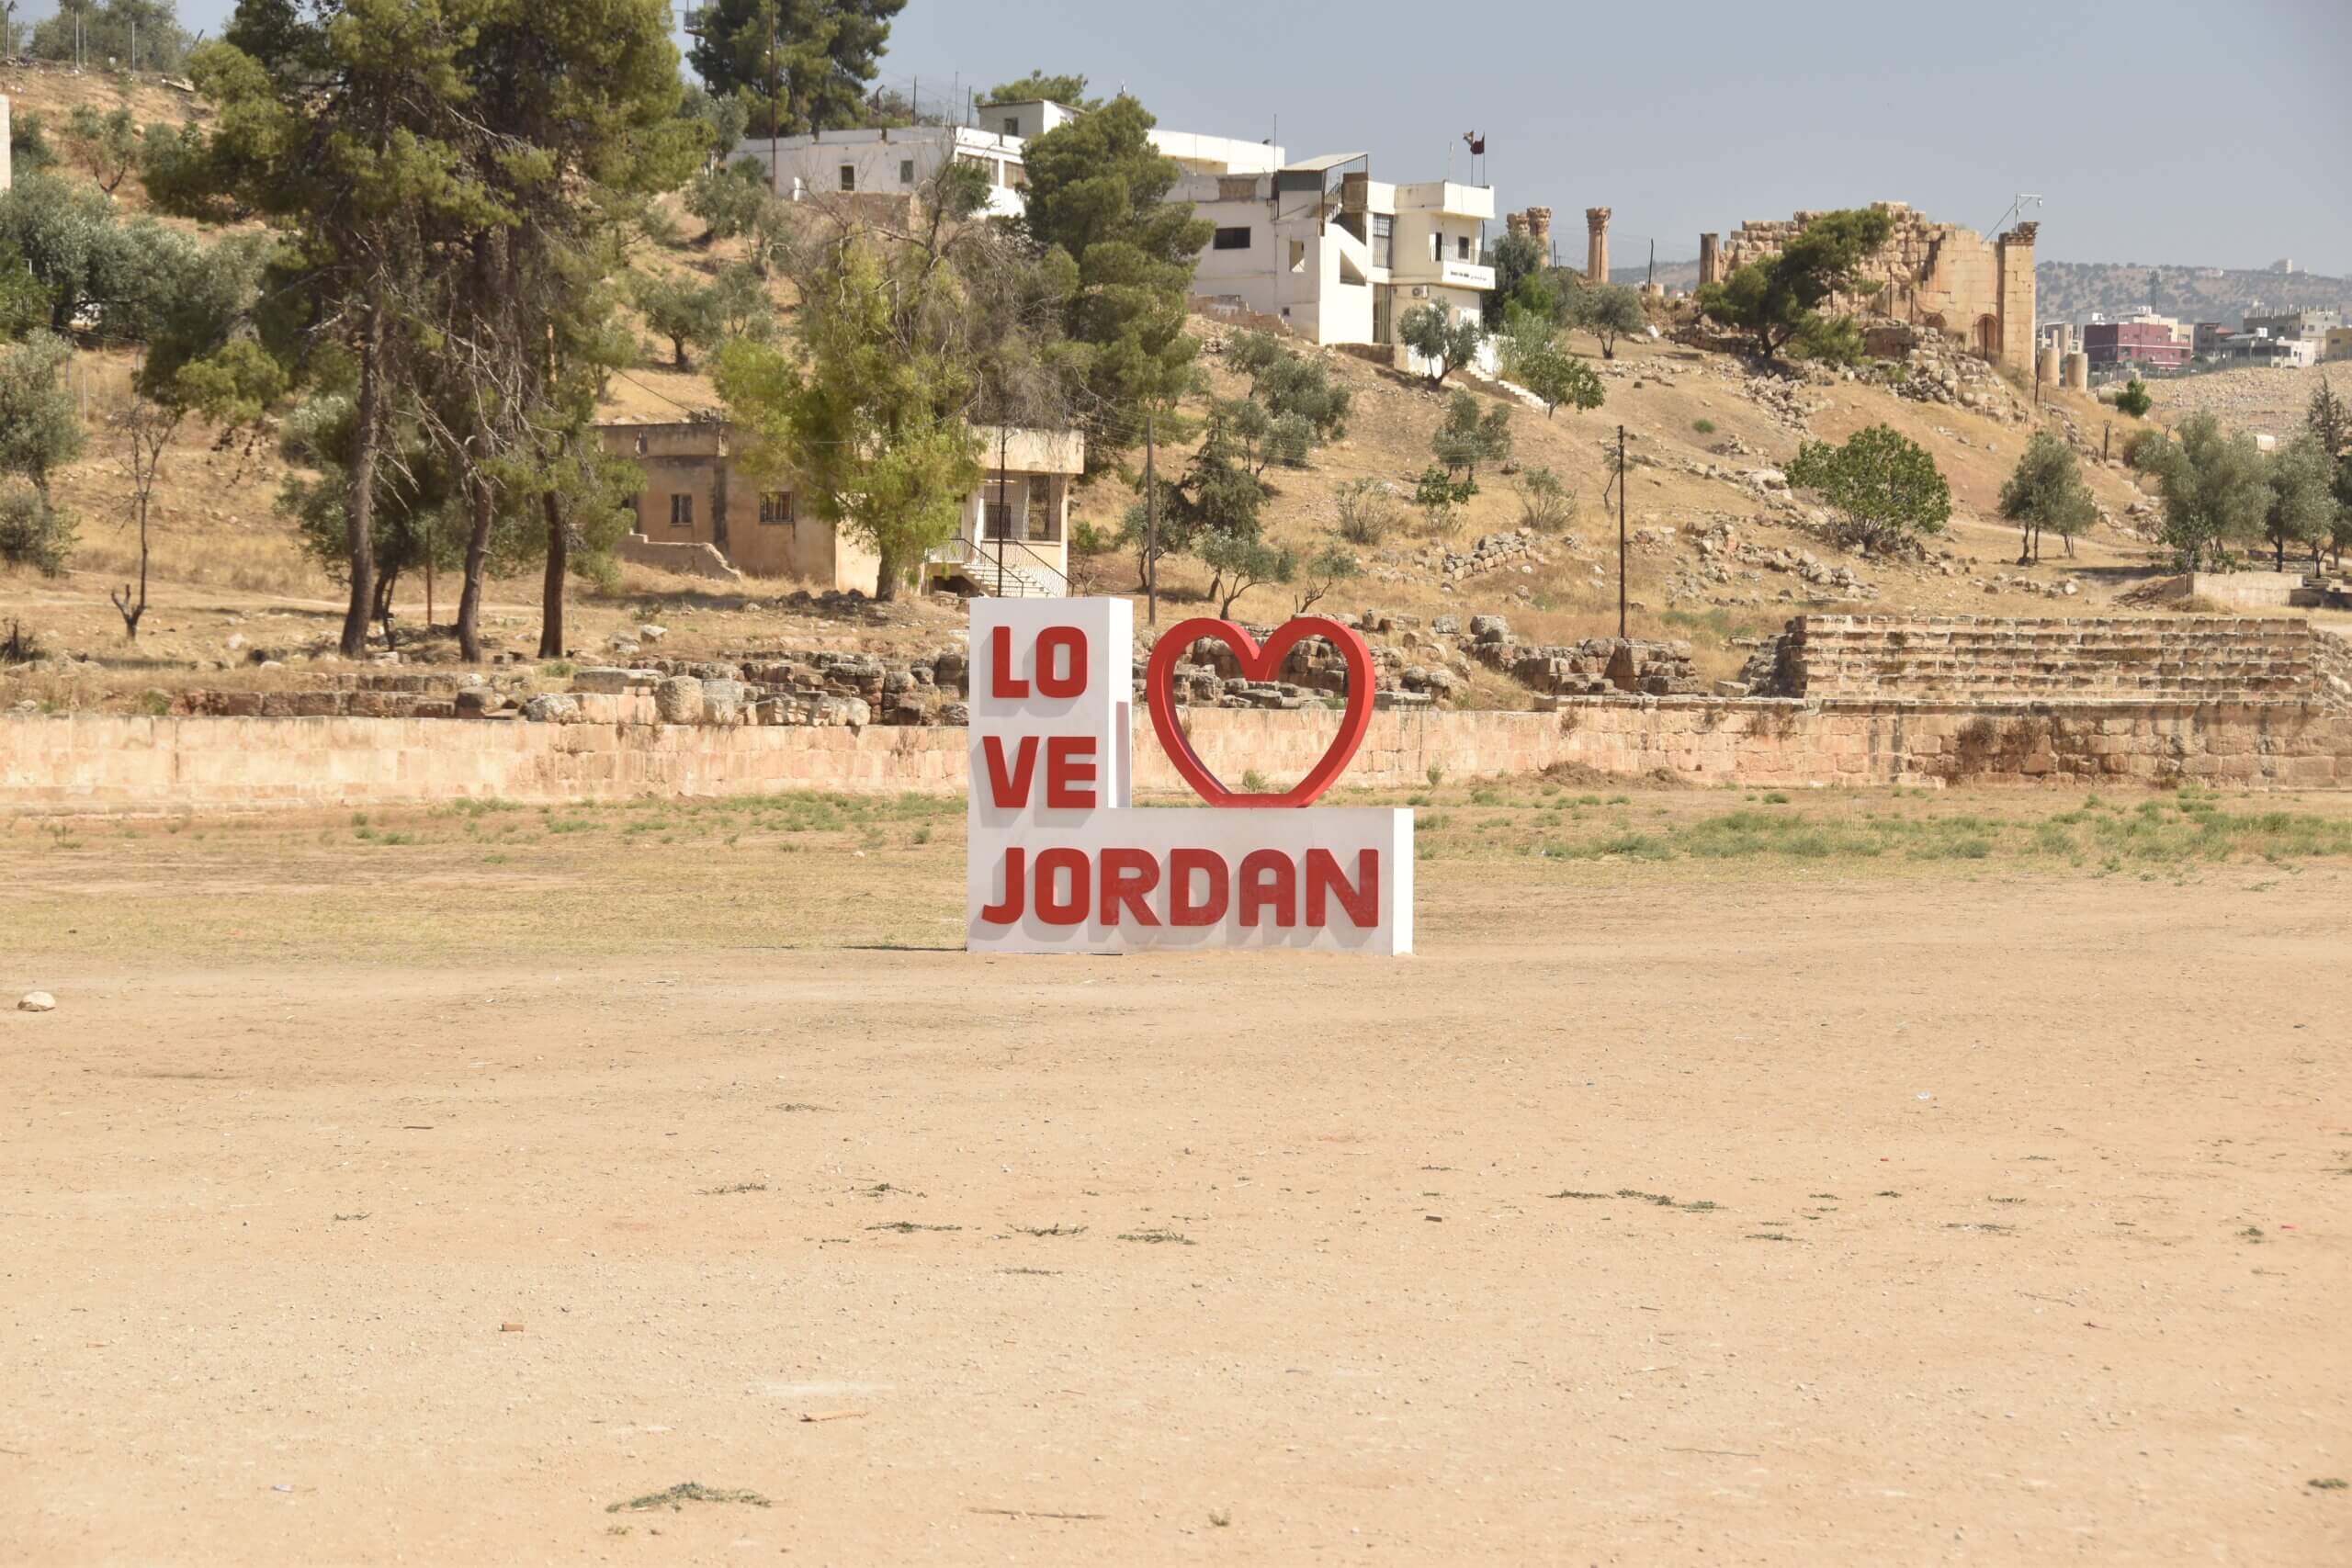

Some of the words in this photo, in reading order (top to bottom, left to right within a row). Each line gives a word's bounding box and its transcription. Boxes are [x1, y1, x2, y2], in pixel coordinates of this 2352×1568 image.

[992, 626, 1088, 699] LO
[982, 735, 1097, 808] VE
[981, 847, 1379, 927] JORDAN
